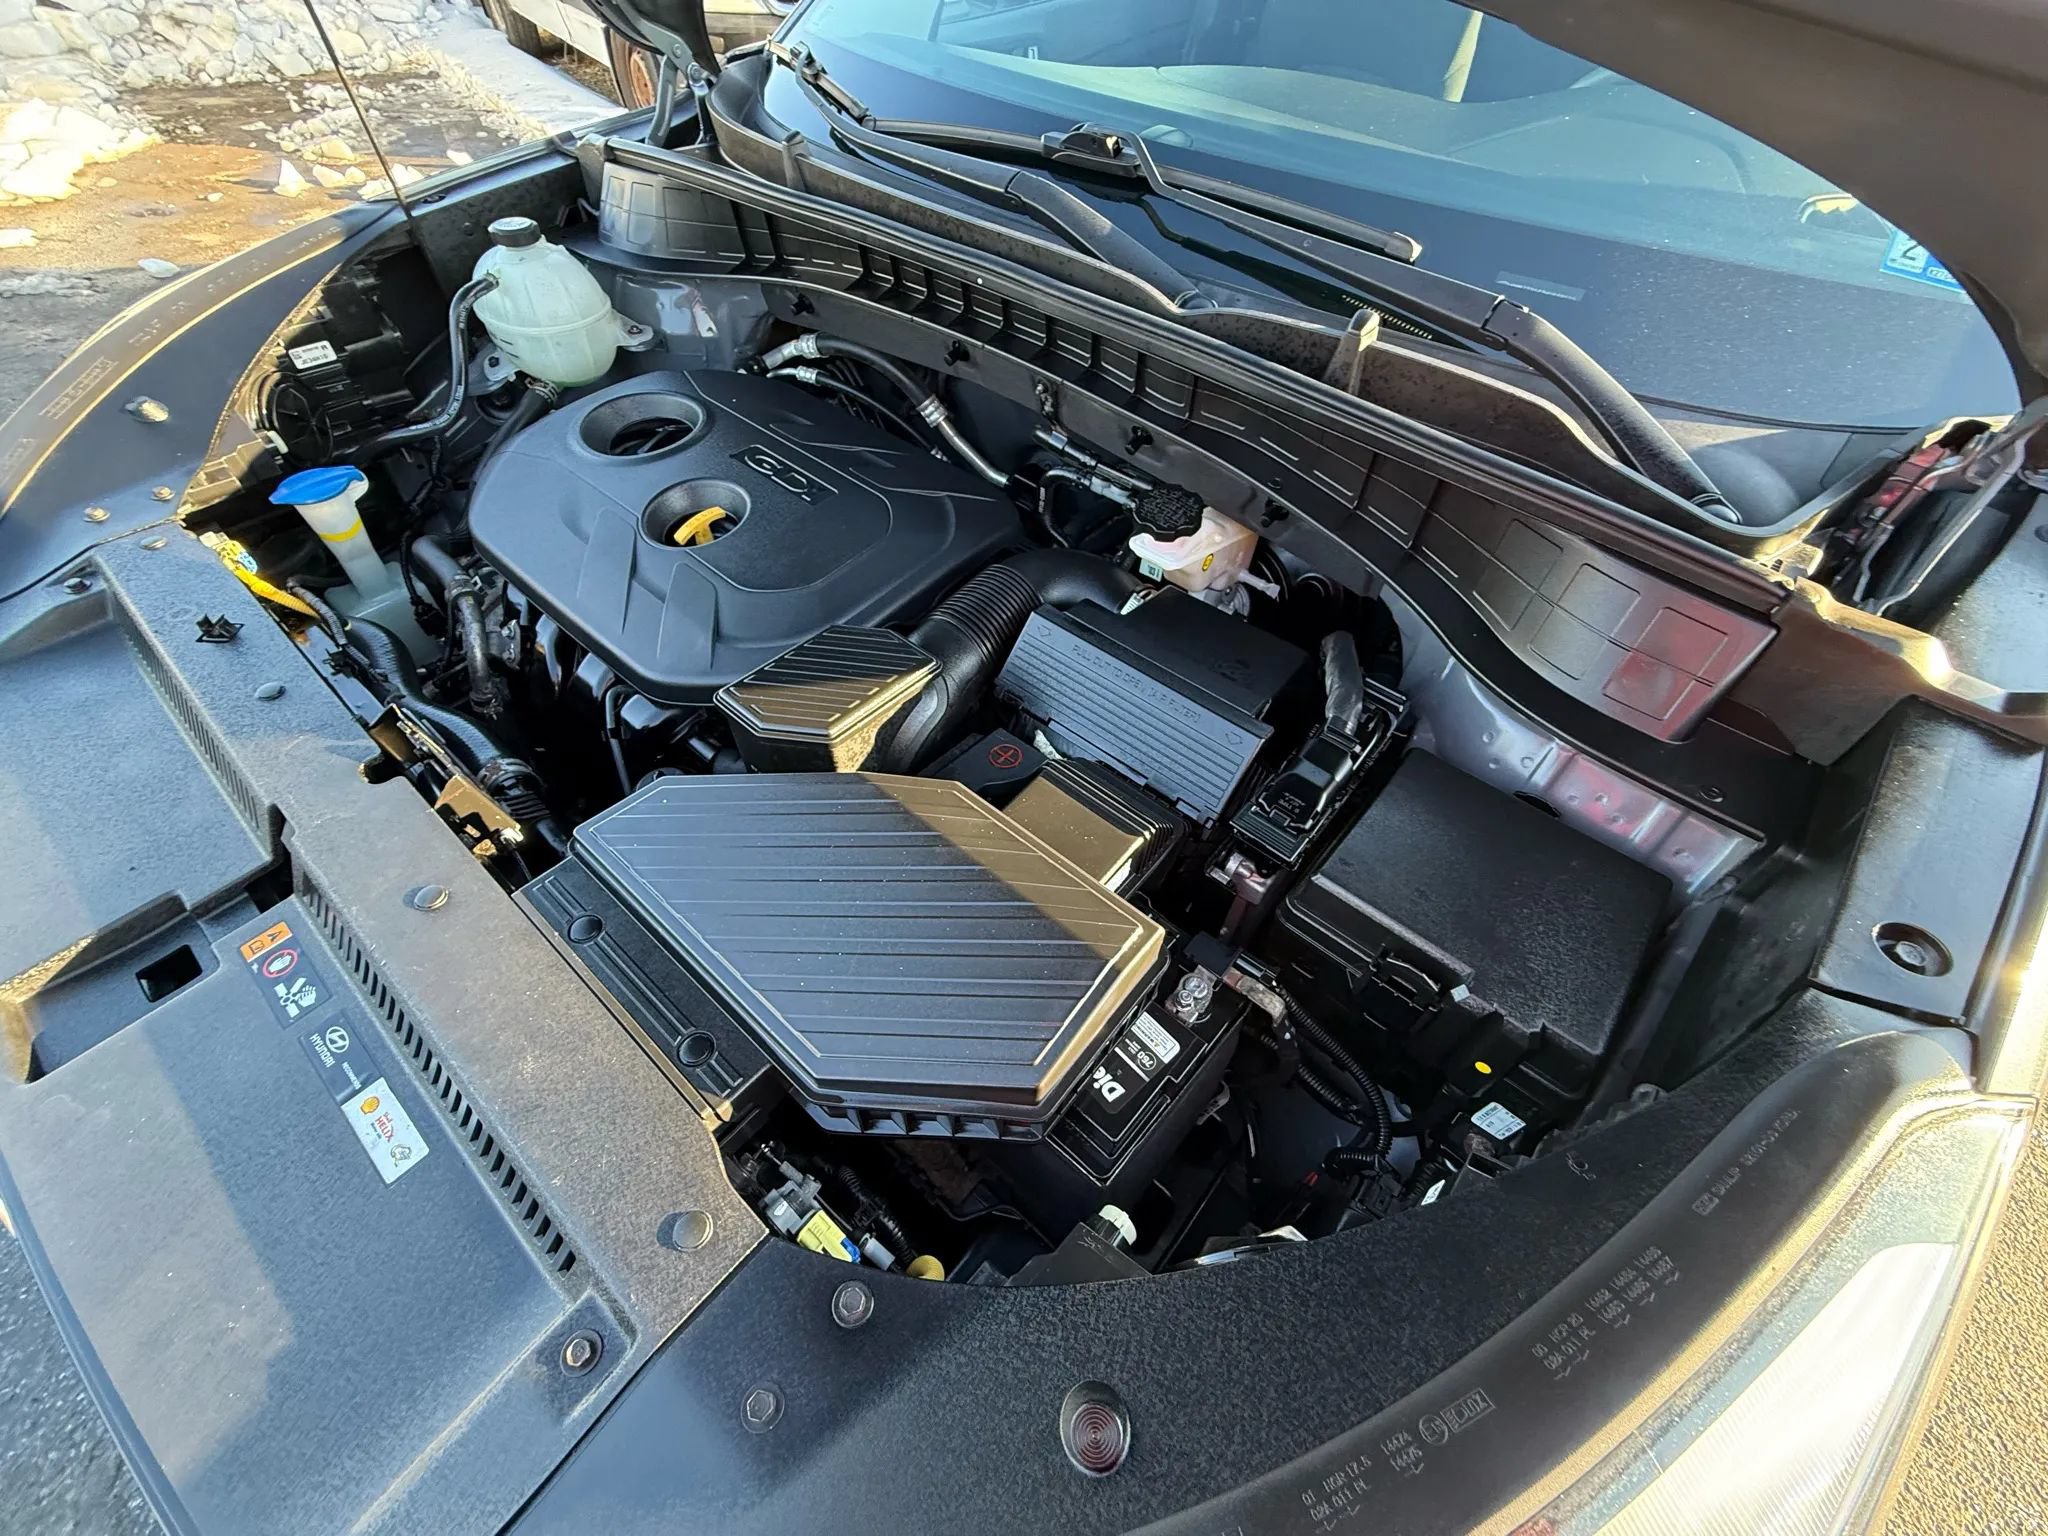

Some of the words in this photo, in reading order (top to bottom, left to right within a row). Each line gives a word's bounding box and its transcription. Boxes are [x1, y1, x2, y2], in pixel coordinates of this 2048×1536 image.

[1072, 644, 1092, 662] PULL
[1092, 655, 1111, 668] OUT
[309, 1032, 336, 1068] HYUNDAI
[1137, 1050, 1154, 1068] 760
[375, 1115, 395, 1142] HELIX
